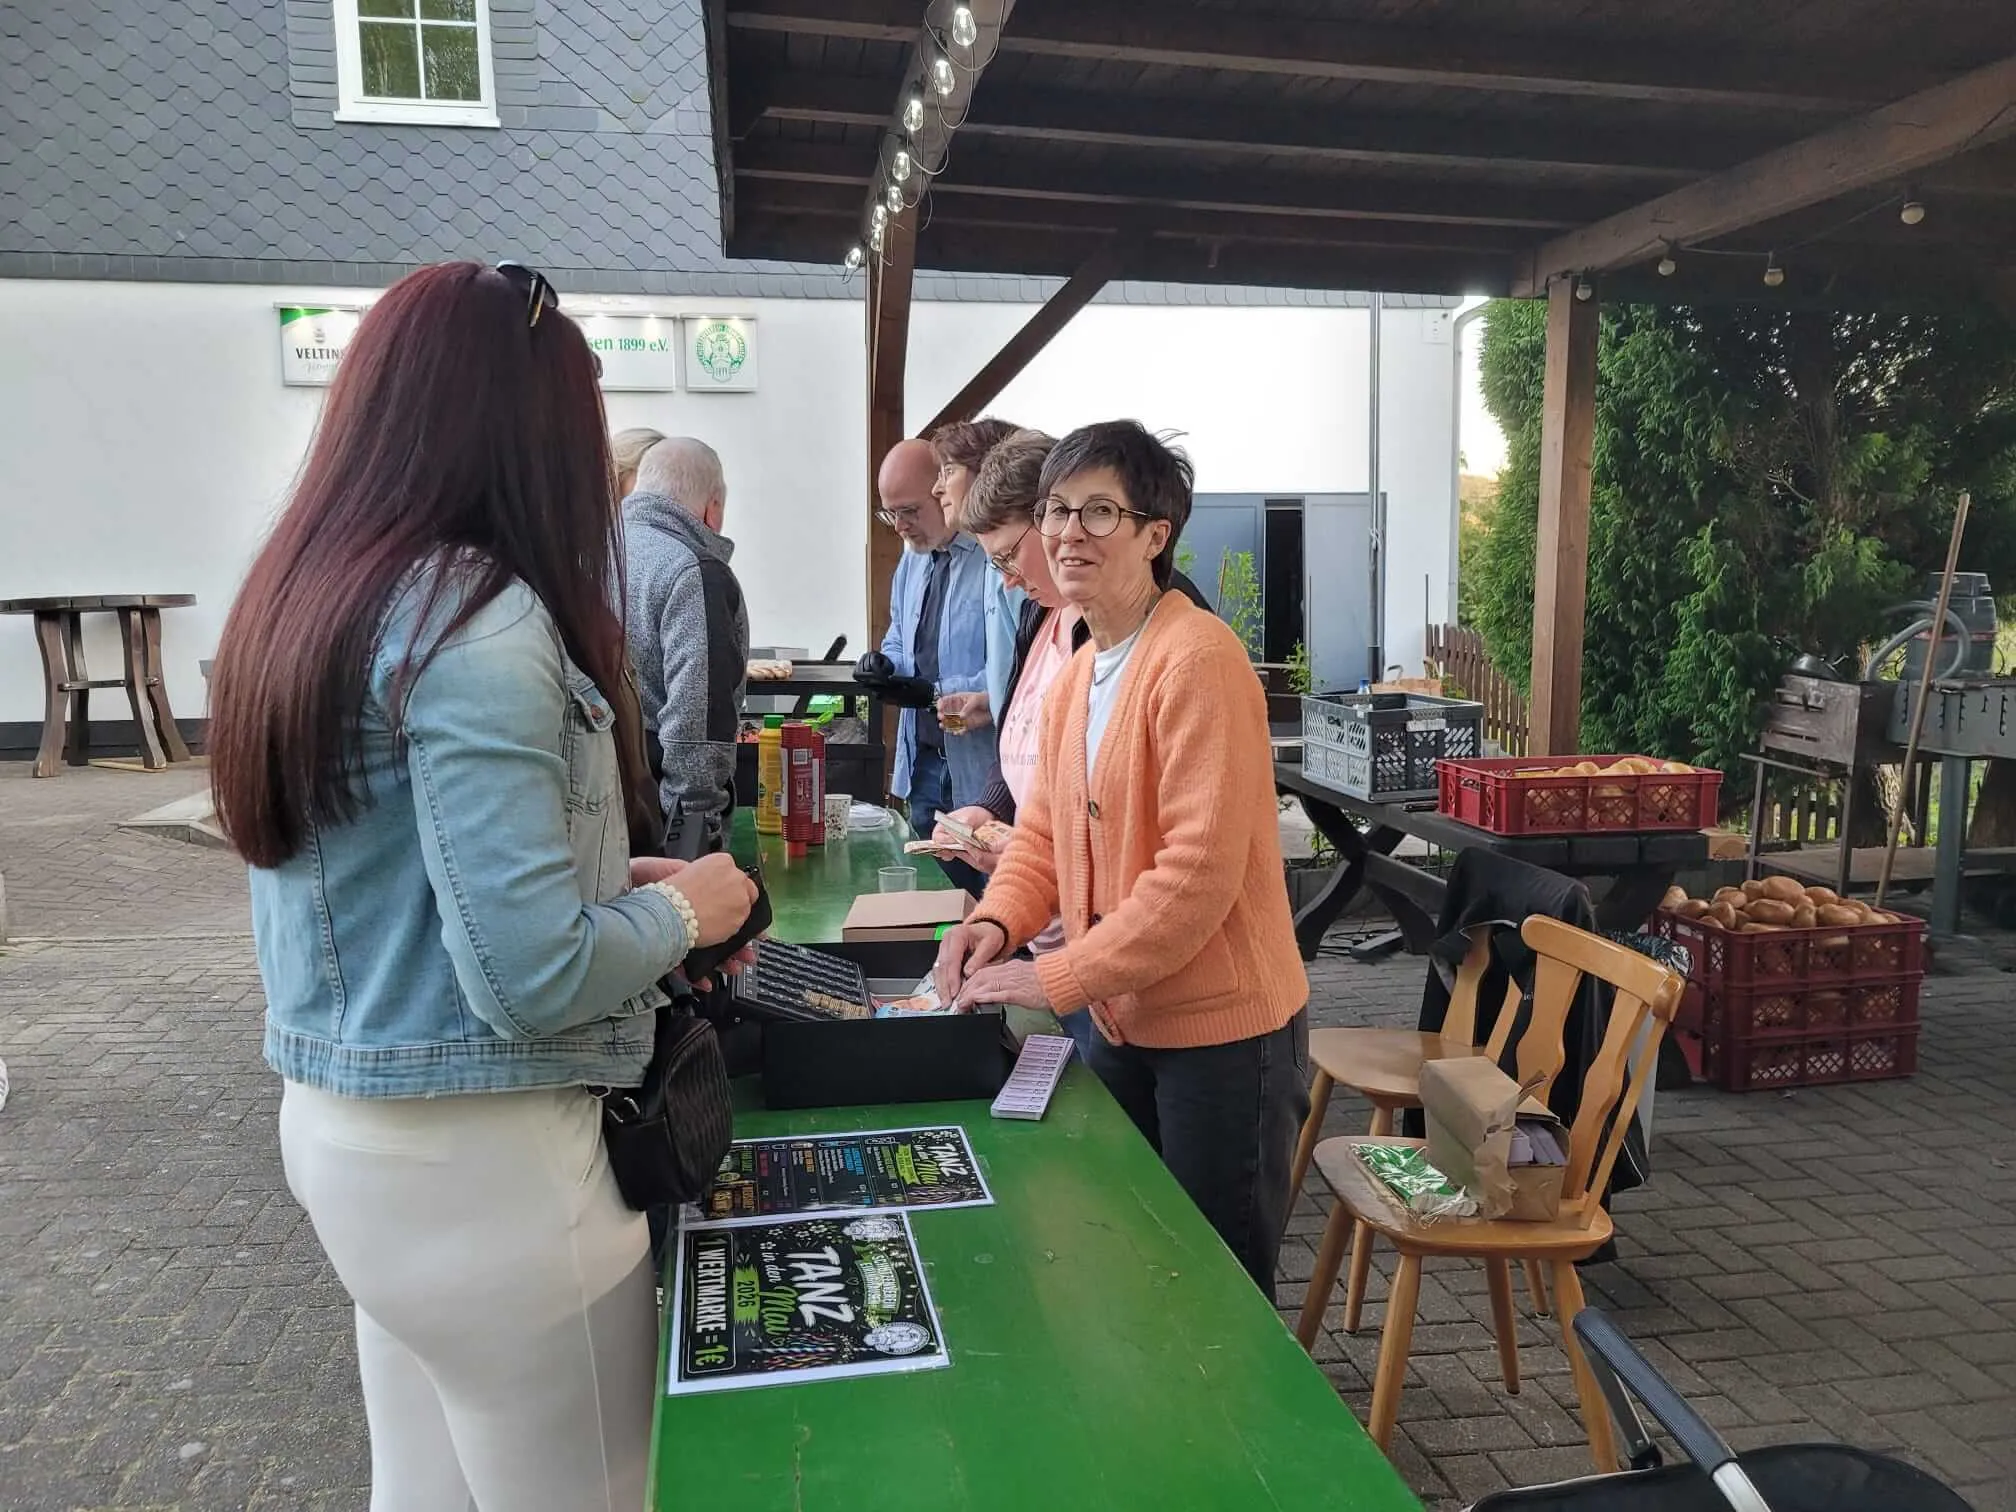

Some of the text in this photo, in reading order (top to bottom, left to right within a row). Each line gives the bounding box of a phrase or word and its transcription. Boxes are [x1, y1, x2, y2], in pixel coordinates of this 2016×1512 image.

[295, 348, 345, 360] VELTIN
[619, 338, 646, 351] 1899
[650, 339, 669, 352] e.V.
[913, 1159, 942, 1185] Mai
[927, 1142, 969, 1177] TANZ
[696, 1248, 726, 1333] WERTMARKE
[736, 1280, 756, 1308] 2026
[760, 1252, 798, 1336] in den Mai
[784, 1245, 856, 1328] TANZ
[695, 1345, 729, 1367] 1€
